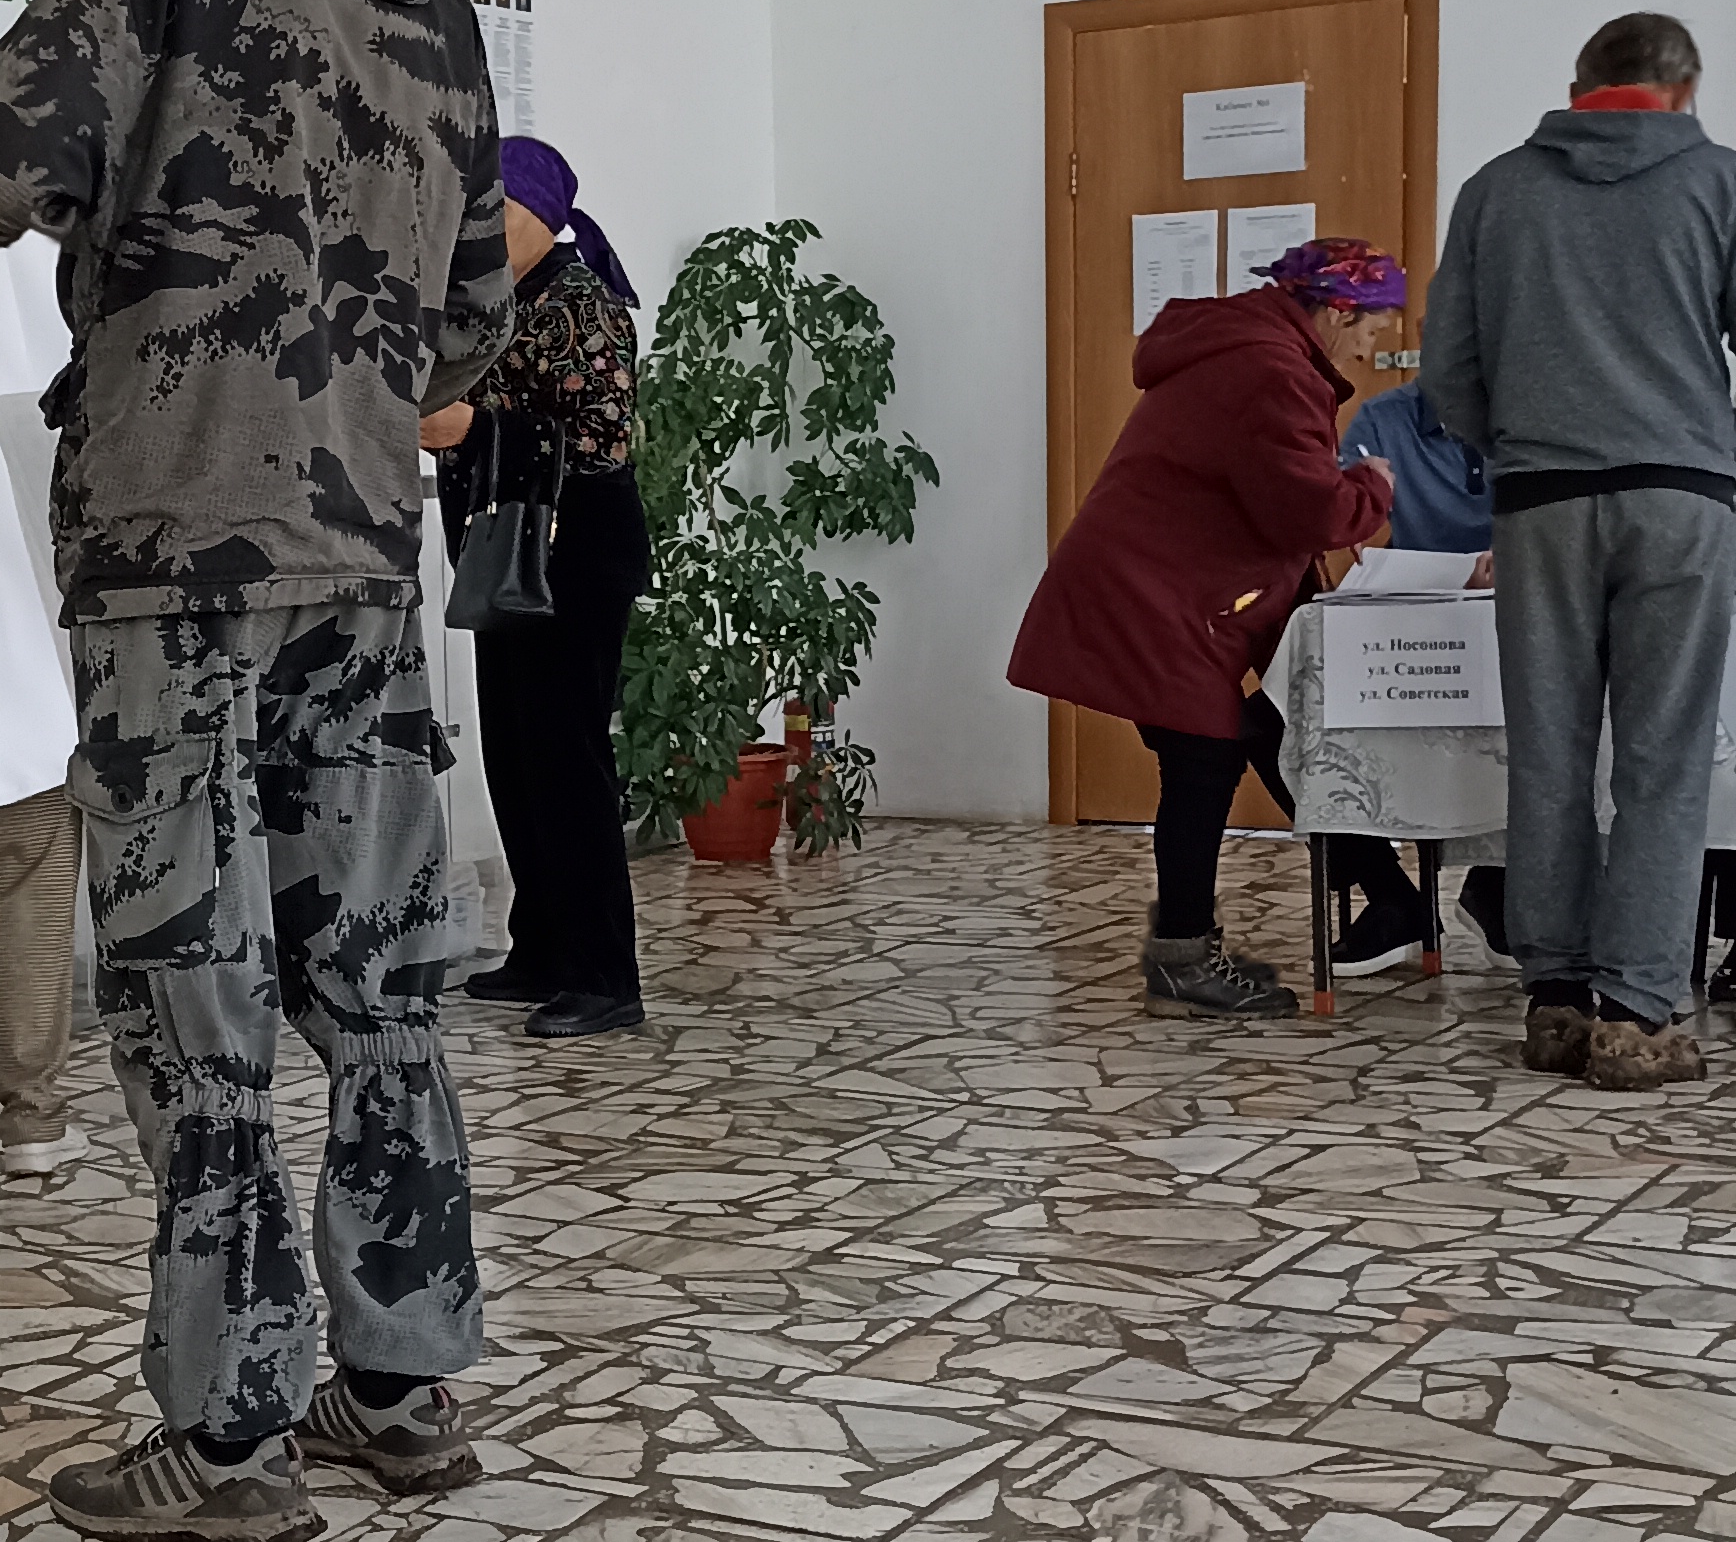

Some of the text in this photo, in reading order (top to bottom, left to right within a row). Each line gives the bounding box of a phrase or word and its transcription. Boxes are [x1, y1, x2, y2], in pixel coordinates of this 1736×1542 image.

[1362, 641, 1385, 655] ул.
[1367, 662, 1461, 679] ул. Садовая
[1359, 686, 1469, 703] ул. Советская
